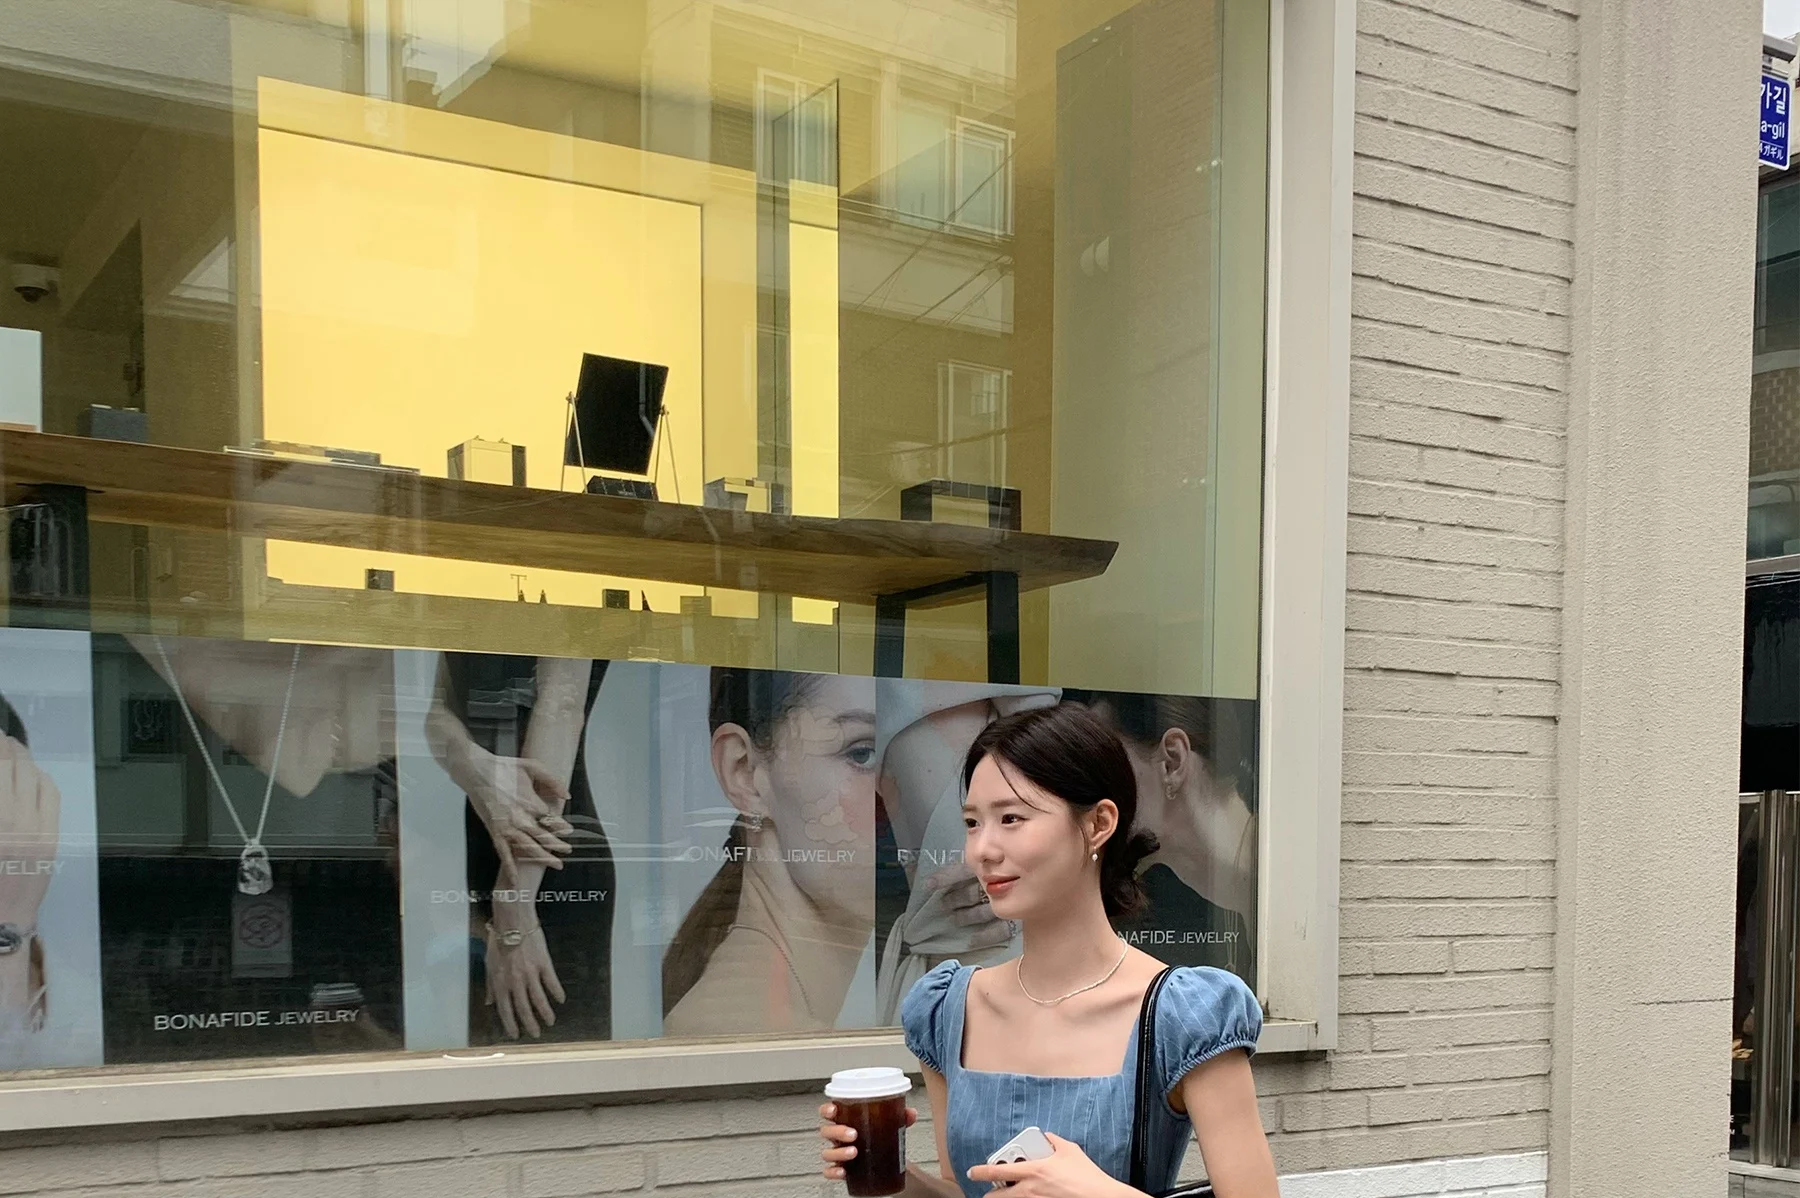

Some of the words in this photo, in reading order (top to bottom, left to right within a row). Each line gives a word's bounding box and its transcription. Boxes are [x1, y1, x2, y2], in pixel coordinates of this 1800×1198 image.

[1761, 120, 1785, 140] a-gil
[781, 849, 856, 863] JEWELRY
[535, 890, 608, 903] JEWELRY
[1179, 931, 1240, 944] JEWELRY
[154, 1010, 270, 1031] BONAFIDE
[274, 1009, 360, 1026] JEWELRY
